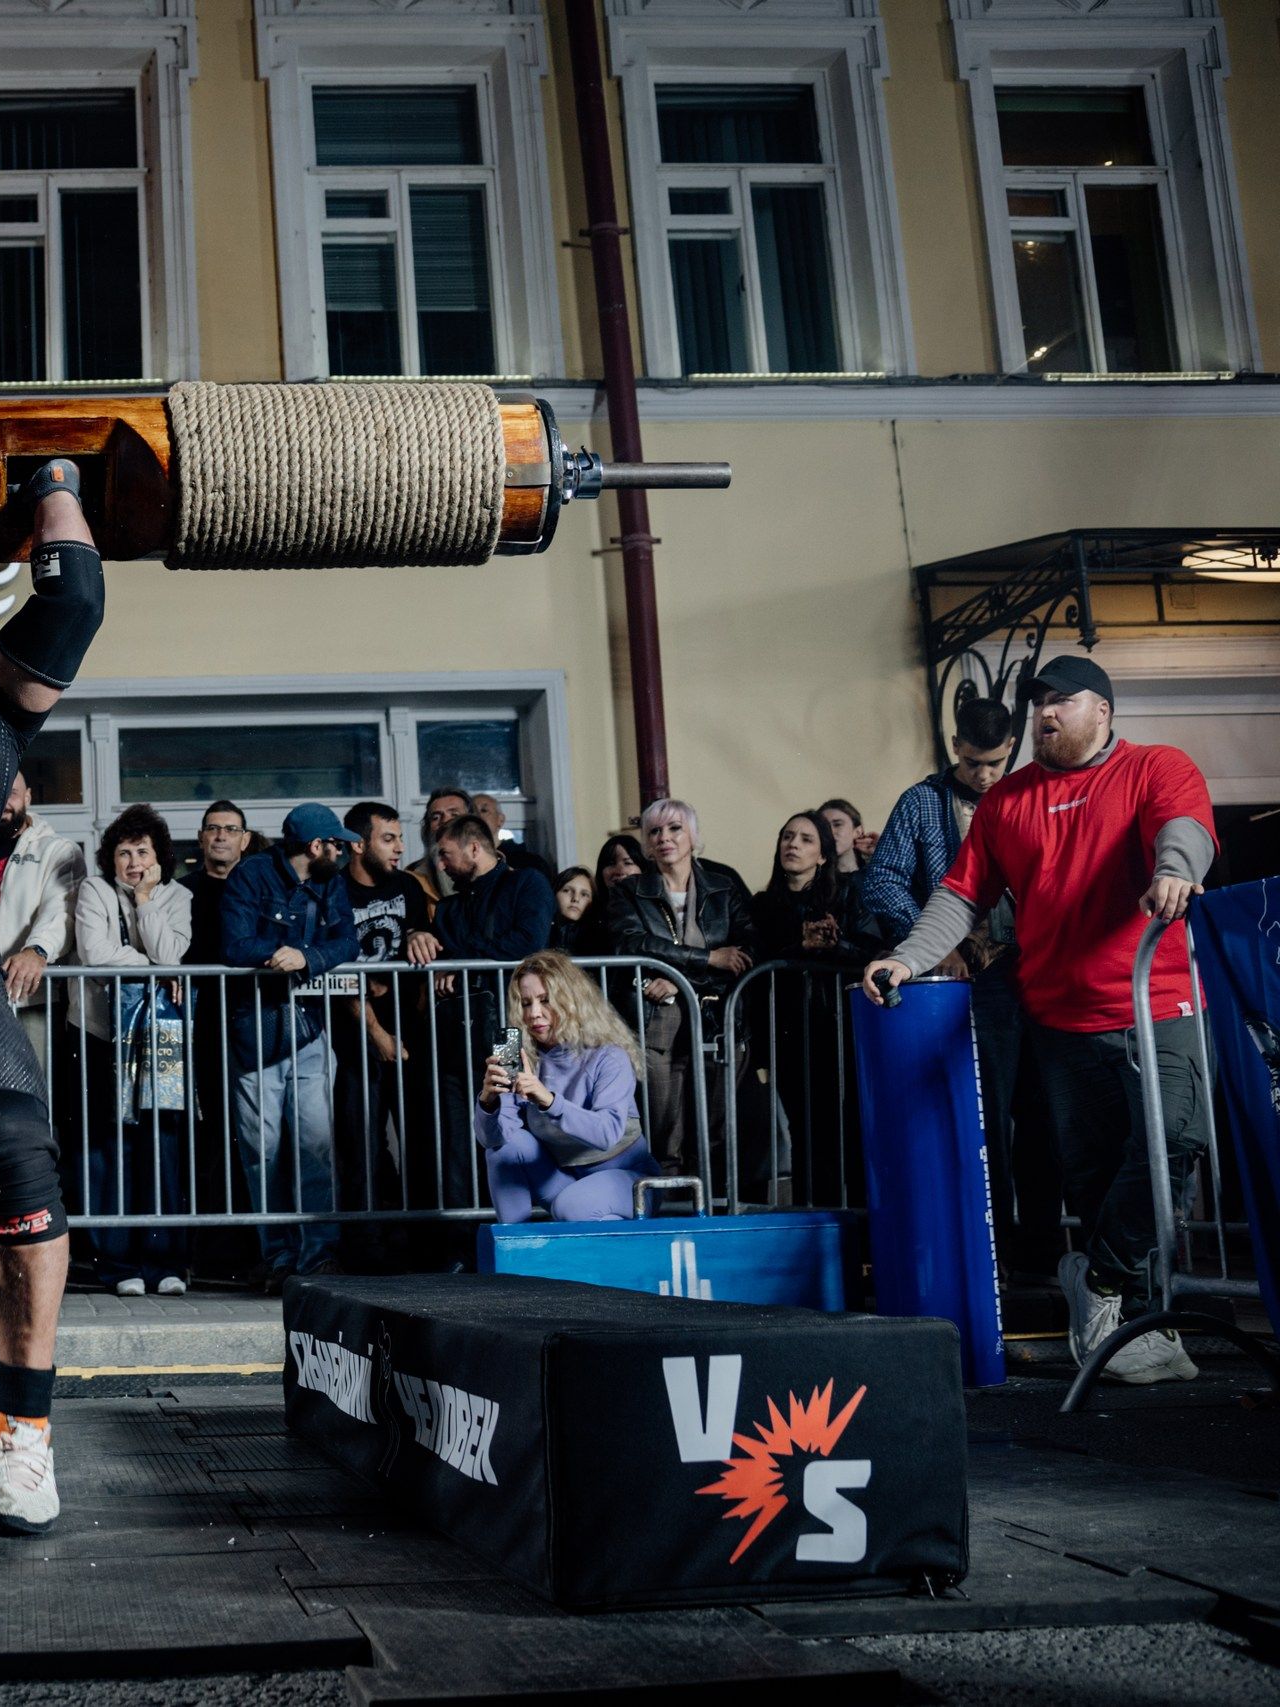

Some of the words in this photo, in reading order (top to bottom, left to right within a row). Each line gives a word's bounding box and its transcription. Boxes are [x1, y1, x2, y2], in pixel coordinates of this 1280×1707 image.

[393, 1370, 500, 1487] ЧЕЛОВЕК
[662, 1353, 741, 1463] V
[796, 1459, 871, 1563] S
